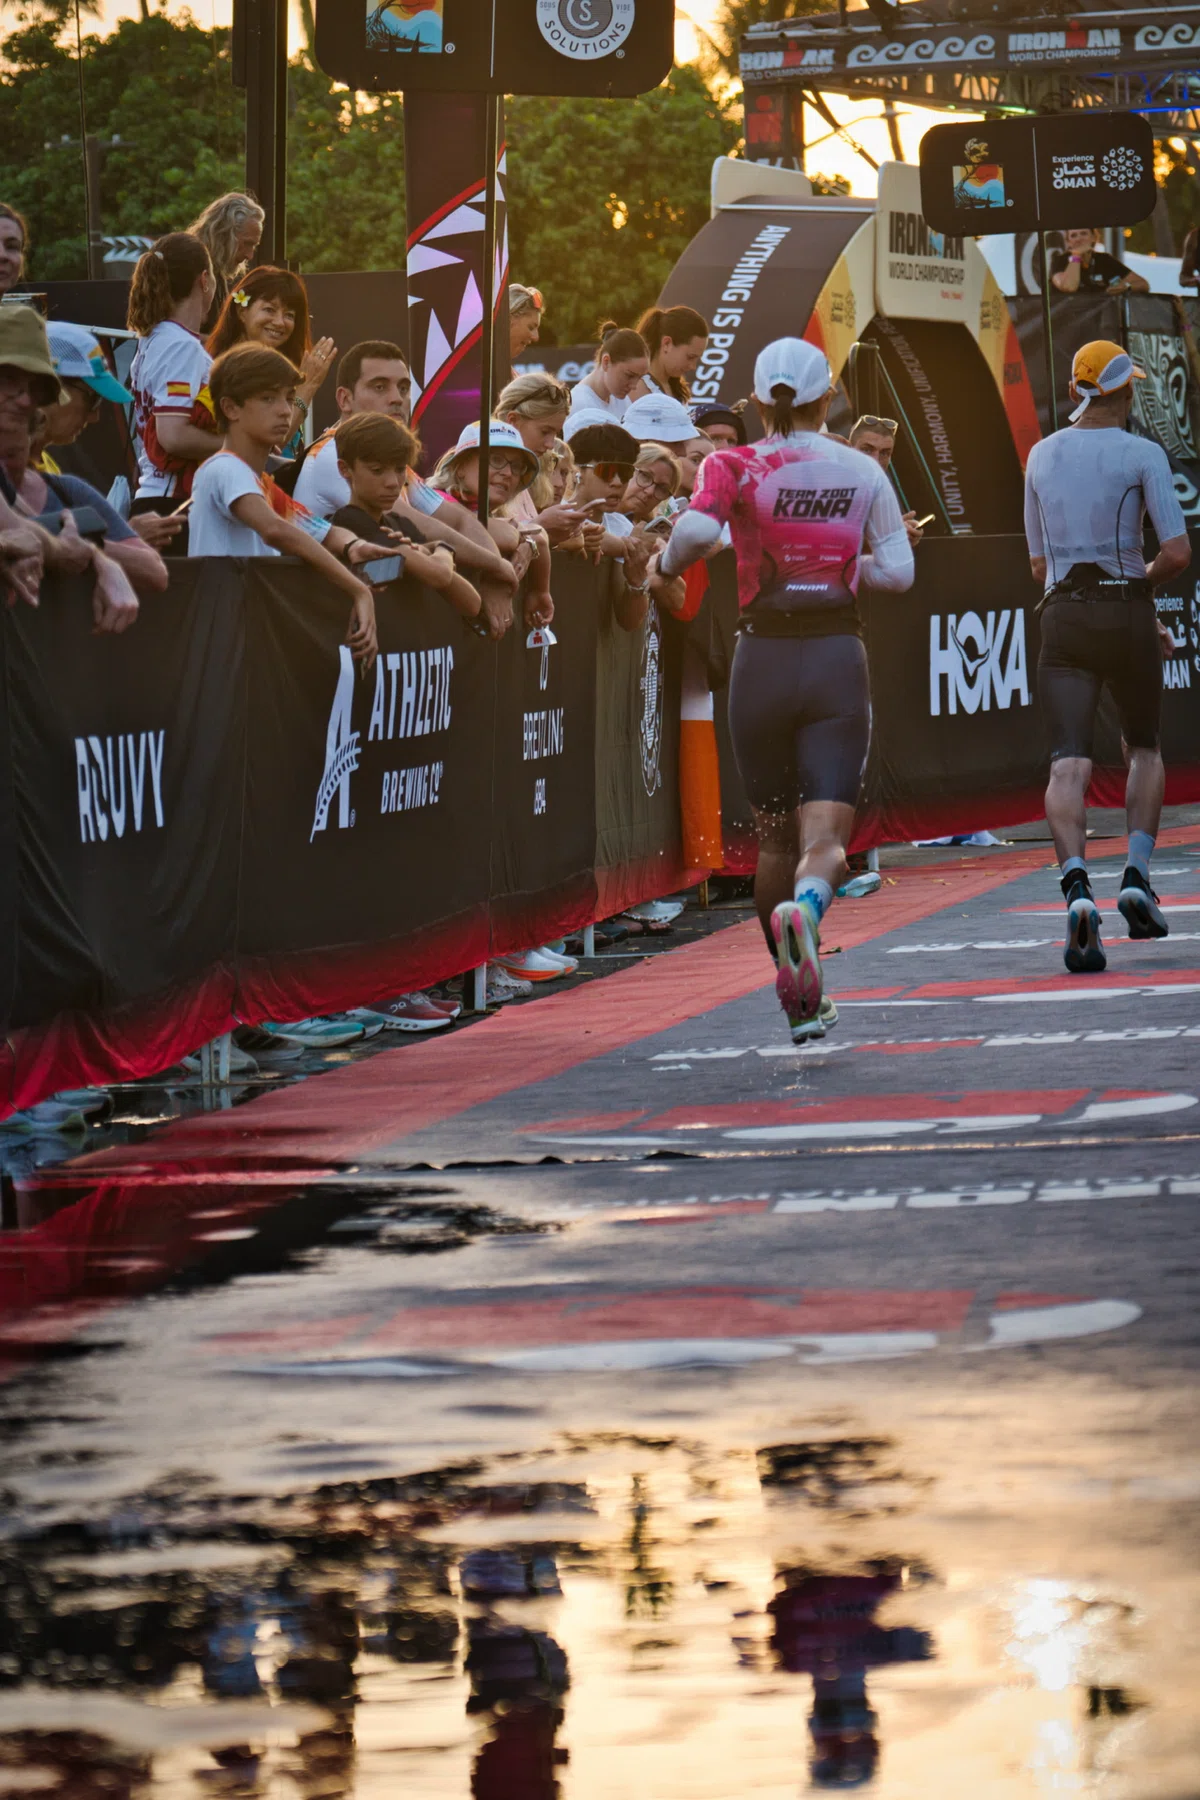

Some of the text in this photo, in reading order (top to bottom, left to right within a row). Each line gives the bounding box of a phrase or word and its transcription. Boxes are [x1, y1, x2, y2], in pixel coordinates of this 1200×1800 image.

[545, 20, 626, 54] SOLUTIONS
[1008, 21, 1121, 51] IRONMAN
[1009, 48, 1121, 62] WORLD CHAMPIONSHIP
[1052, 155, 1095, 163] Experience
[1053, 177, 1096, 189] OMAN
[721, 224, 792, 302] ANYTHING
[889, 261, 964, 285] WORLD CHAMPIONSHIP
[712, 307, 745, 327] IS
[772, 498, 853, 518] KONA
[777, 487, 858, 499] TEAM ZOOT
[1154, 593, 1184, 612] perience
[930, 607, 1029, 716] HOKA
[1163, 659, 1191, 690] MAN
[368, 645, 454, 741] ATHLETIC
[523, 707, 564, 761] BREITLING
[75, 730, 165, 843] ROUVY
[381, 765, 429, 814] BREWING
